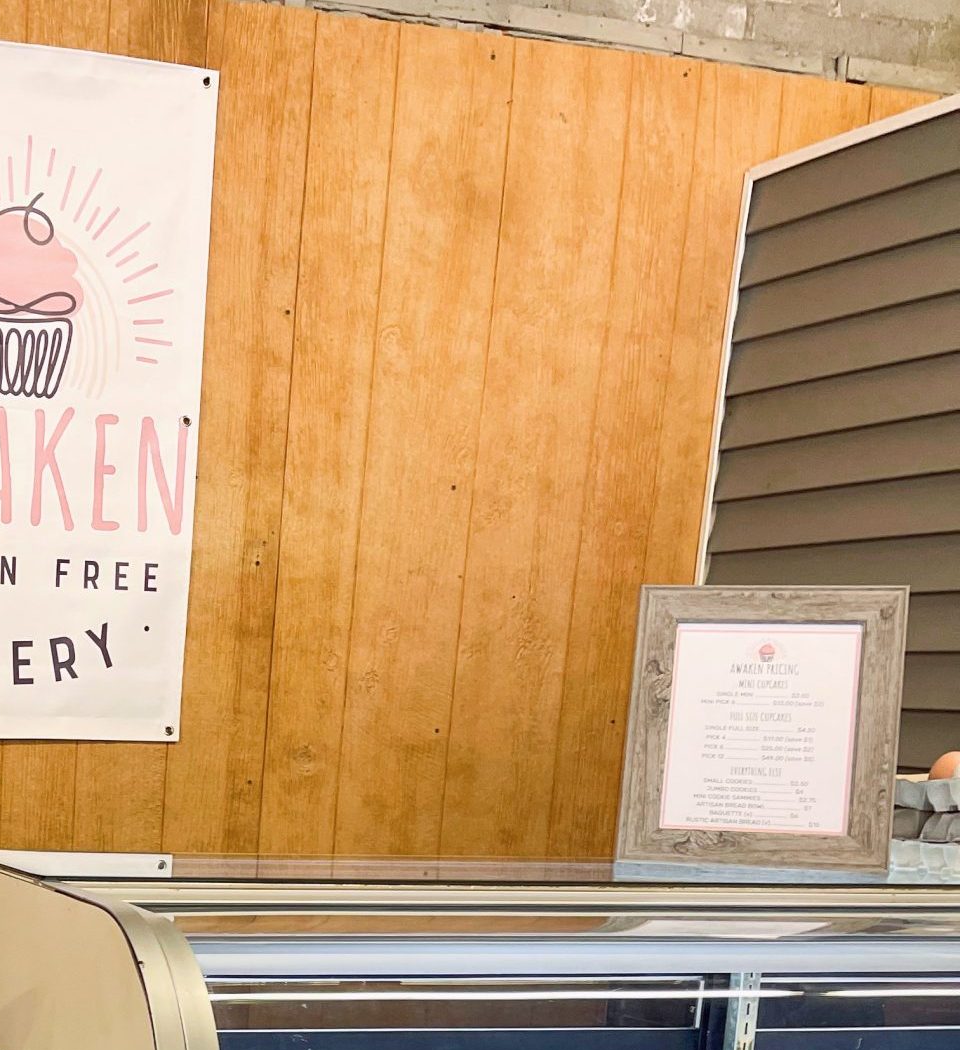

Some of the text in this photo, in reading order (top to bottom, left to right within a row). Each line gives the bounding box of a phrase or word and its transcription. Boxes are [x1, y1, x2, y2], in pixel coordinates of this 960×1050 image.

[55, 559, 159, 592] FREE
[730, 663, 800, 676] AWAKEN PRICING
[738, 679, 788, 690] MINI CUPCAKES
[729, 711, 743, 721] FULL
[760, 712, 792, 722] CUPCAKES
[730, 766, 782, 777] EVERYTHING ELSE
